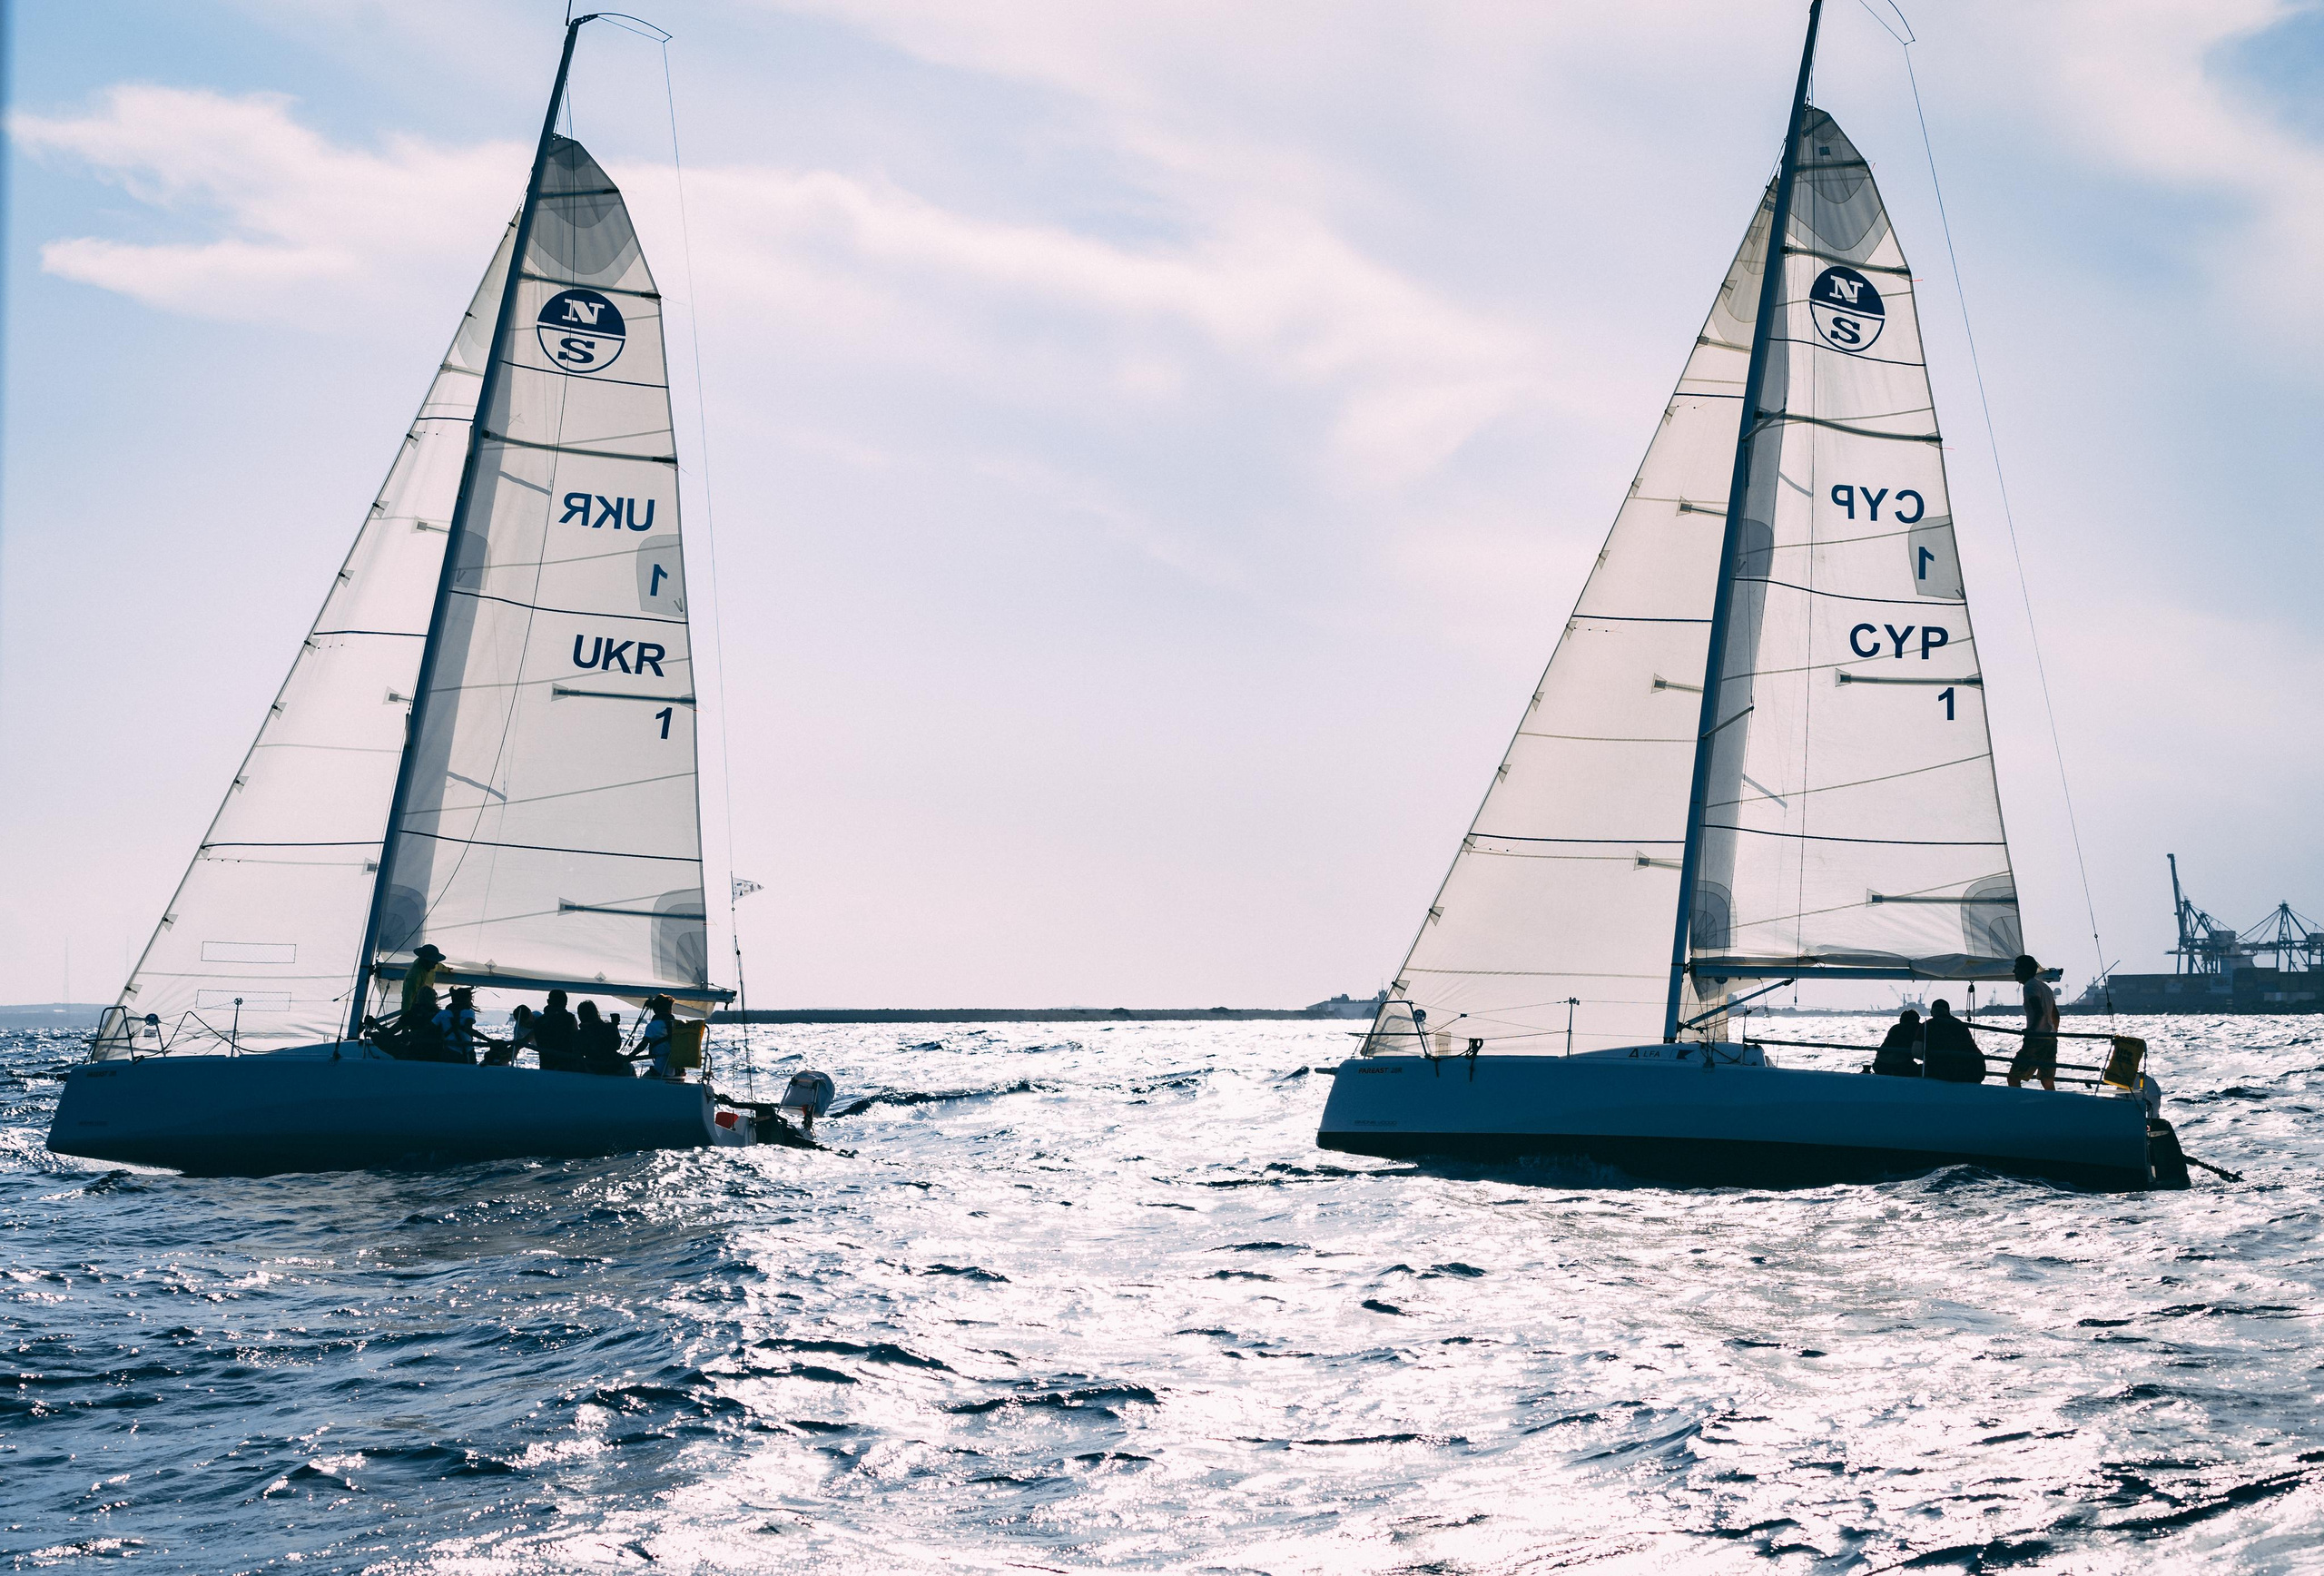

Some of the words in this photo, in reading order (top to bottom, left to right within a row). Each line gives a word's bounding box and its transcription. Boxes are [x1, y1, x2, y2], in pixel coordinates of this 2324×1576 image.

[1829, 274, 1864, 304] N
[562, 298, 606, 325] N
[1830, 316, 1861, 345] S
[557, 337, 596, 364] S
[573, 634, 665, 678] UKR
[1849, 623, 1949, 660] CYP
[1937, 686, 1955, 721] 1
[655, 706, 673, 740] 1
